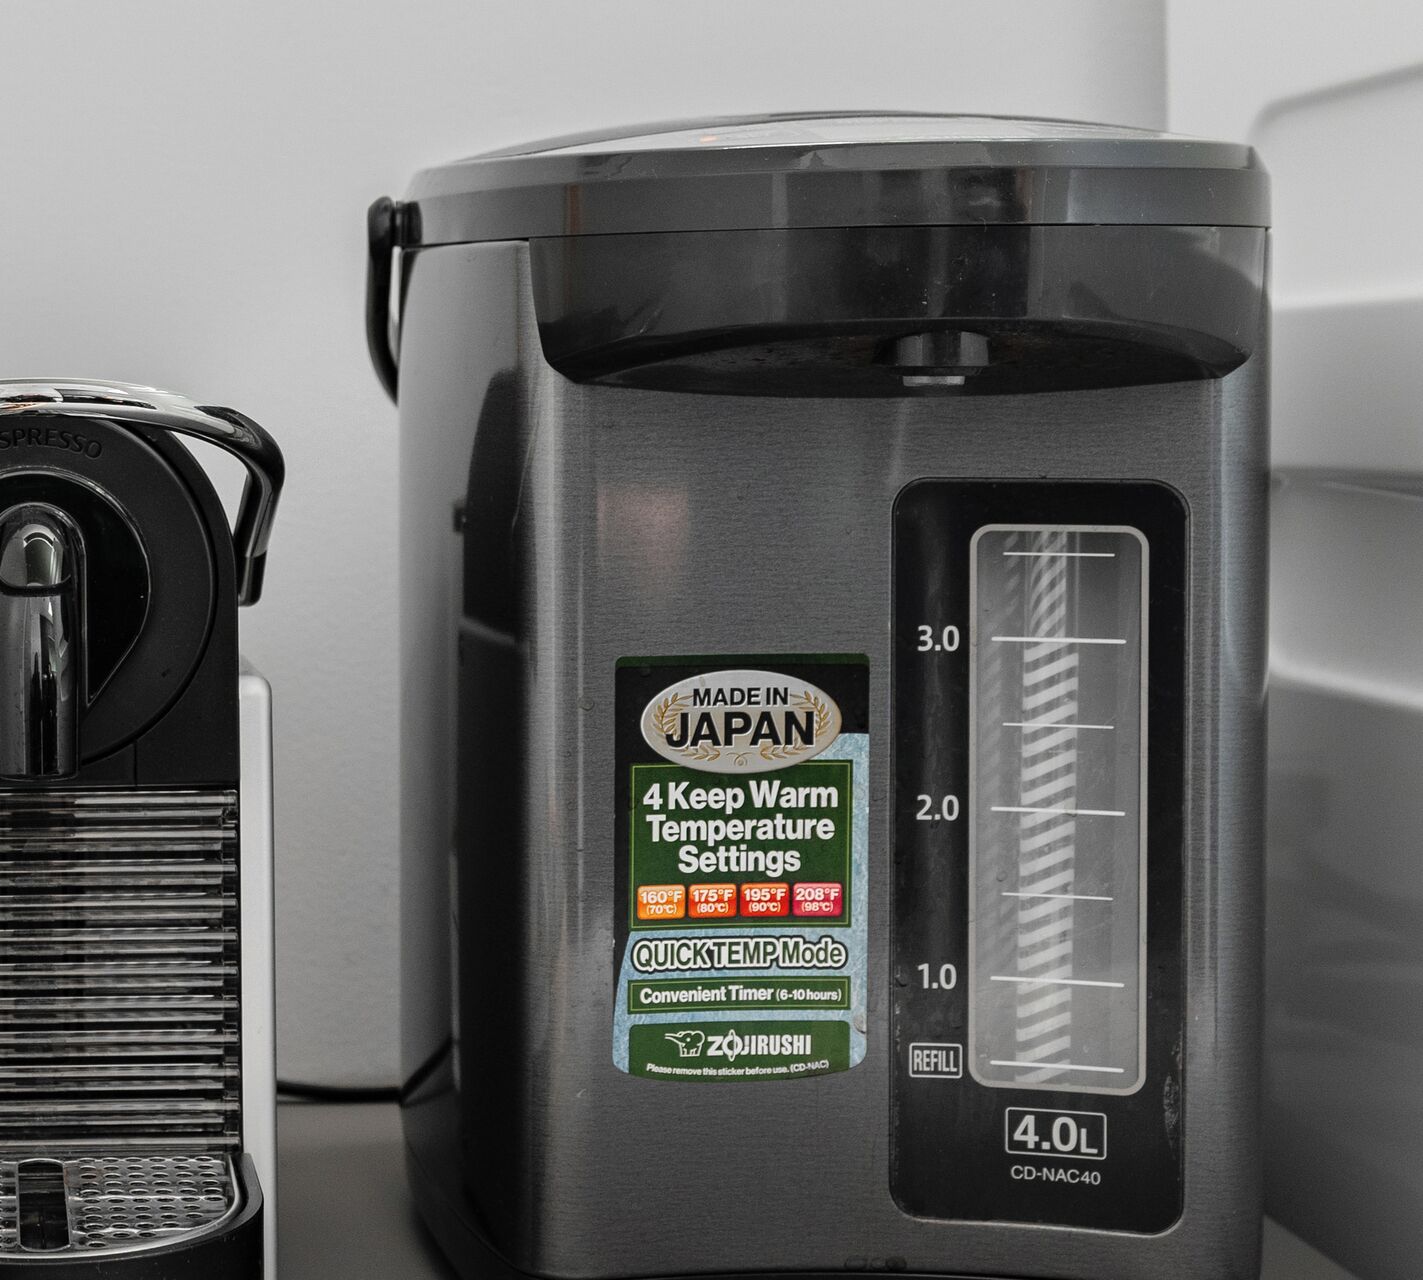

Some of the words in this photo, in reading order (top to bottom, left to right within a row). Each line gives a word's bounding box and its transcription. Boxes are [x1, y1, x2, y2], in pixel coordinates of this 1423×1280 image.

[917, 625, 960, 652] 3.0
[693, 688, 761, 706] MADE
[766, 687, 789, 706] IN
[665, 711, 815, 748] JAPAN
[643, 783, 663, 810] 4
[668, 781, 745, 814] Keep
[749, 780, 839, 808] Warm
[916, 794, 960, 821] 2.0
[646, 813, 835, 847] Temperature
[678, 844, 801, 878] Settings
[640, 889, 683, 904] 160°F
[692, 888, 734, 903] 175°F
[744, 888, 786, 902] 195°F
[796, 887, 840, 901] 208°F
[634, 940, 709, 969] QUICK
[712, 939, 777, 966] TEMP
[780, 939, 845, 966] Mode
[917, 963, 957, 990] 1.0
[640, 986, 726, 1004] Convenient
[728, 985, 774, 1001] Timer
[707, 1029, 812, 1062] ZOJIRUSHI
[646, 1063, 672, 1074] Please
[672, 1067, 702, 1076] remove
[703, 1066, 717, 1076] this
[717, 1066, 745, 1076] sticker
[745, 1065, 772, 1075] before
[913, 1050, 958, 1073] REFILL
[1013, 1114, 1098, 1155] 4.0L
[1010, 1165, 1101, 1186] CD-NAC40
